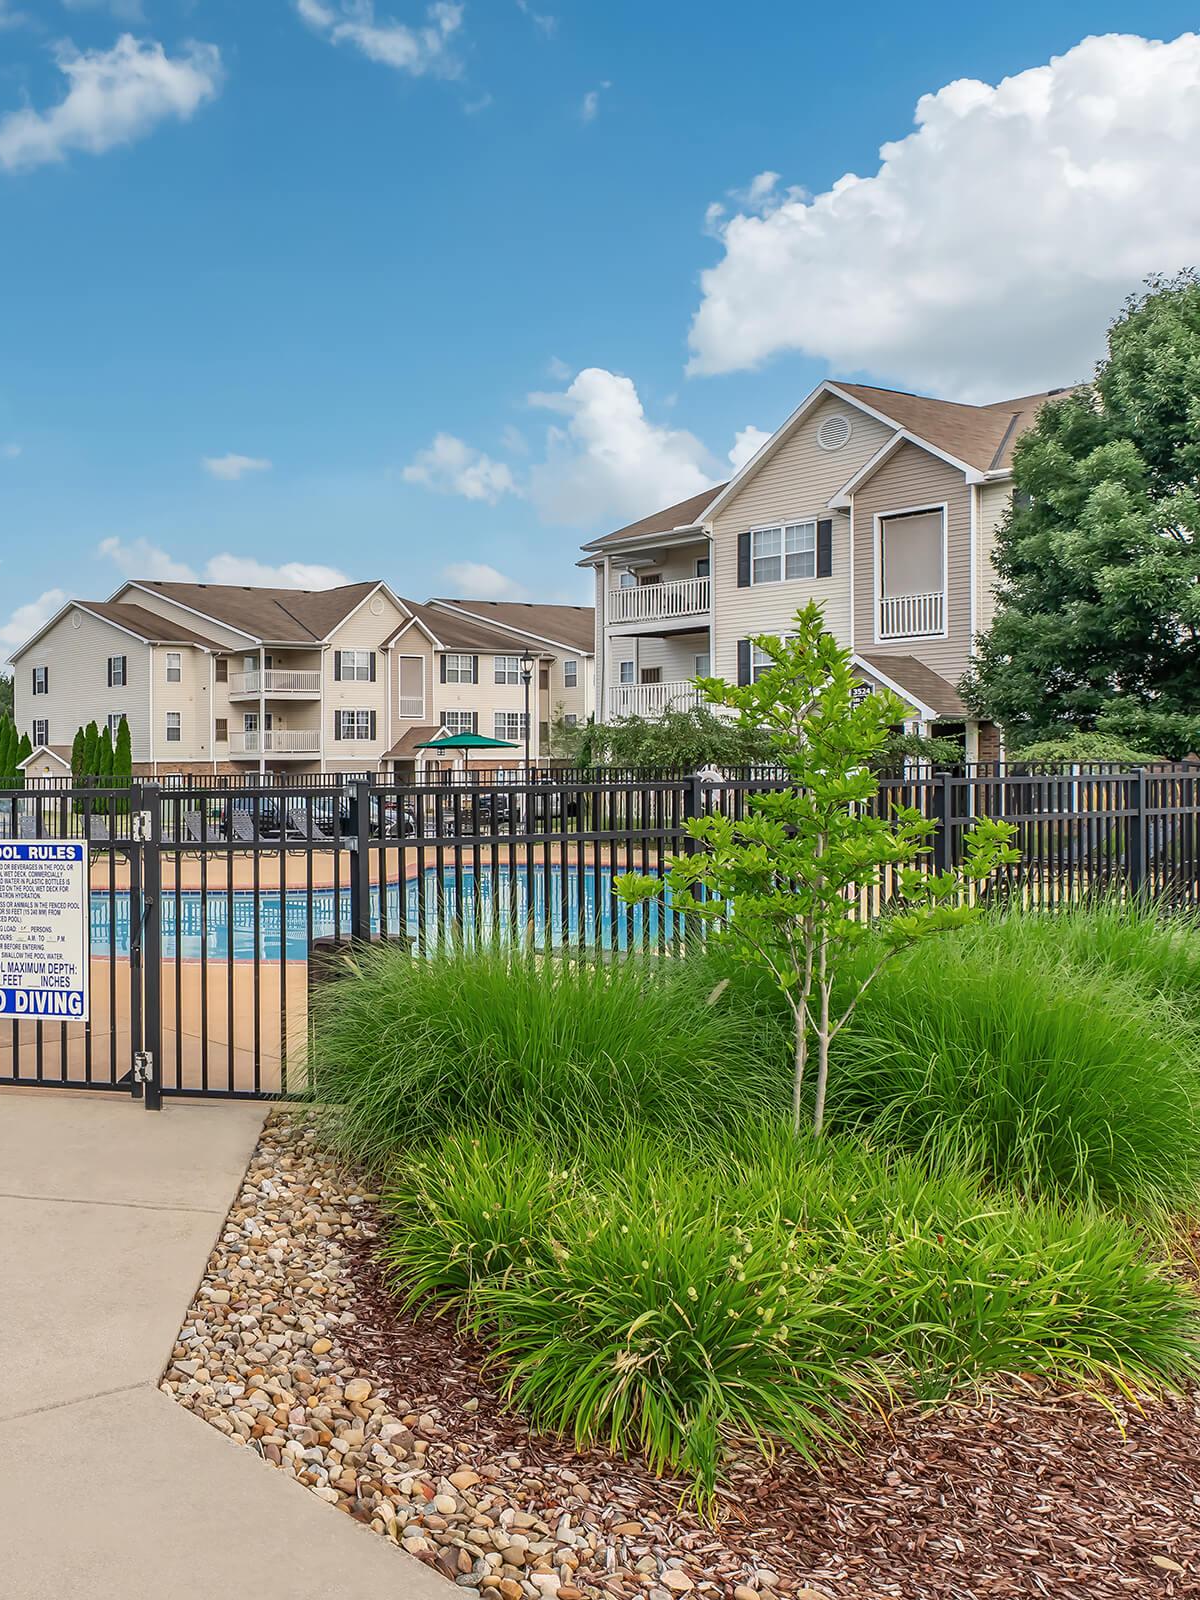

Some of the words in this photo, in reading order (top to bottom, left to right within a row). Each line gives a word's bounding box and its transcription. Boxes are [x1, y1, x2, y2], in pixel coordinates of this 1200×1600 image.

[29, 847, 76, 859] RULES
[8, 962, 45, 974] MAXIMUM
[48, 964, 78, 975] DEPTH:
[3, 975, 22, 986] FEET
[41, 976, 70, 987] INCHES
[15, 991, 82, 1014] DIVING
